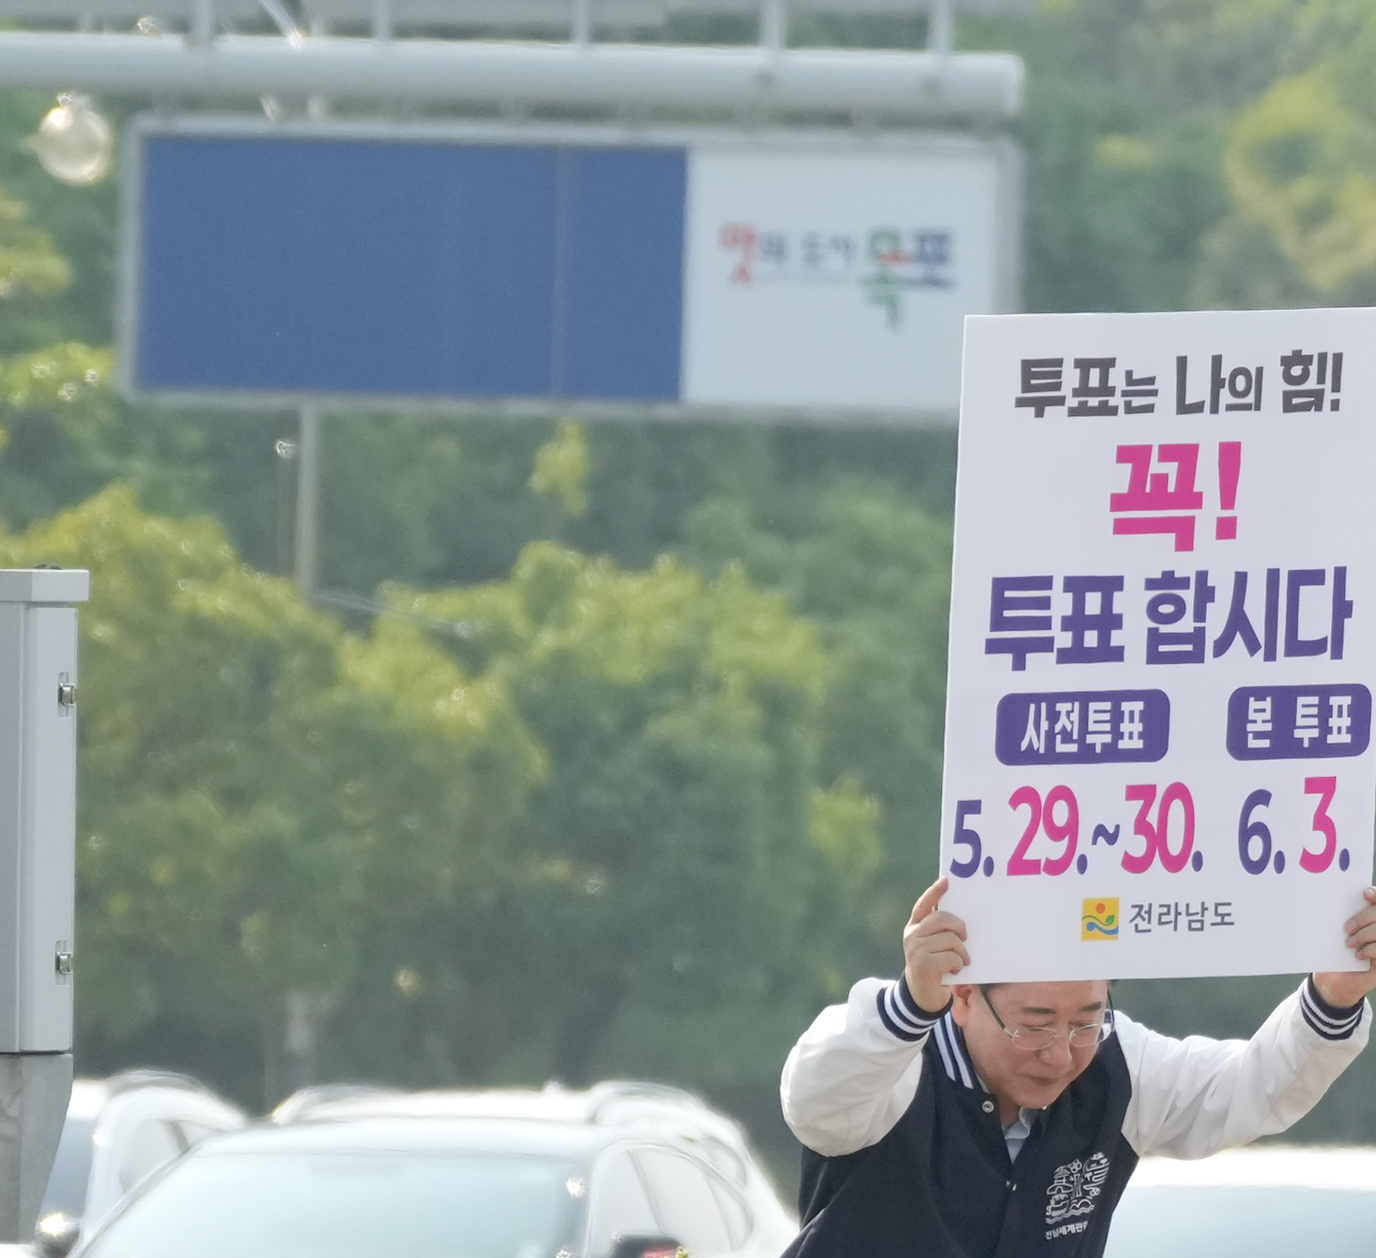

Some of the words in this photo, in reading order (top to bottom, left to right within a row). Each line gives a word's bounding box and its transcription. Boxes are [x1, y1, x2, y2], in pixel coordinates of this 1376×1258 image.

[1014, 356, 1159, 419] 투표는
[1175, 353, 1264, 416] 나의
[1279, 349, 1344, 414] 힘!
[1109, 441, 1242, 553] 꼭!
[984, 575, 1126, 672] 투표
[1144, 565, 1354, 666] 합시다
[1020, 700, 1145, 754] 사전투표
[1246, 696, 1274, 749] 본
[1292, 695, 1353, 748] 투표
[1128, 901, 1236, 934] 전라남도
